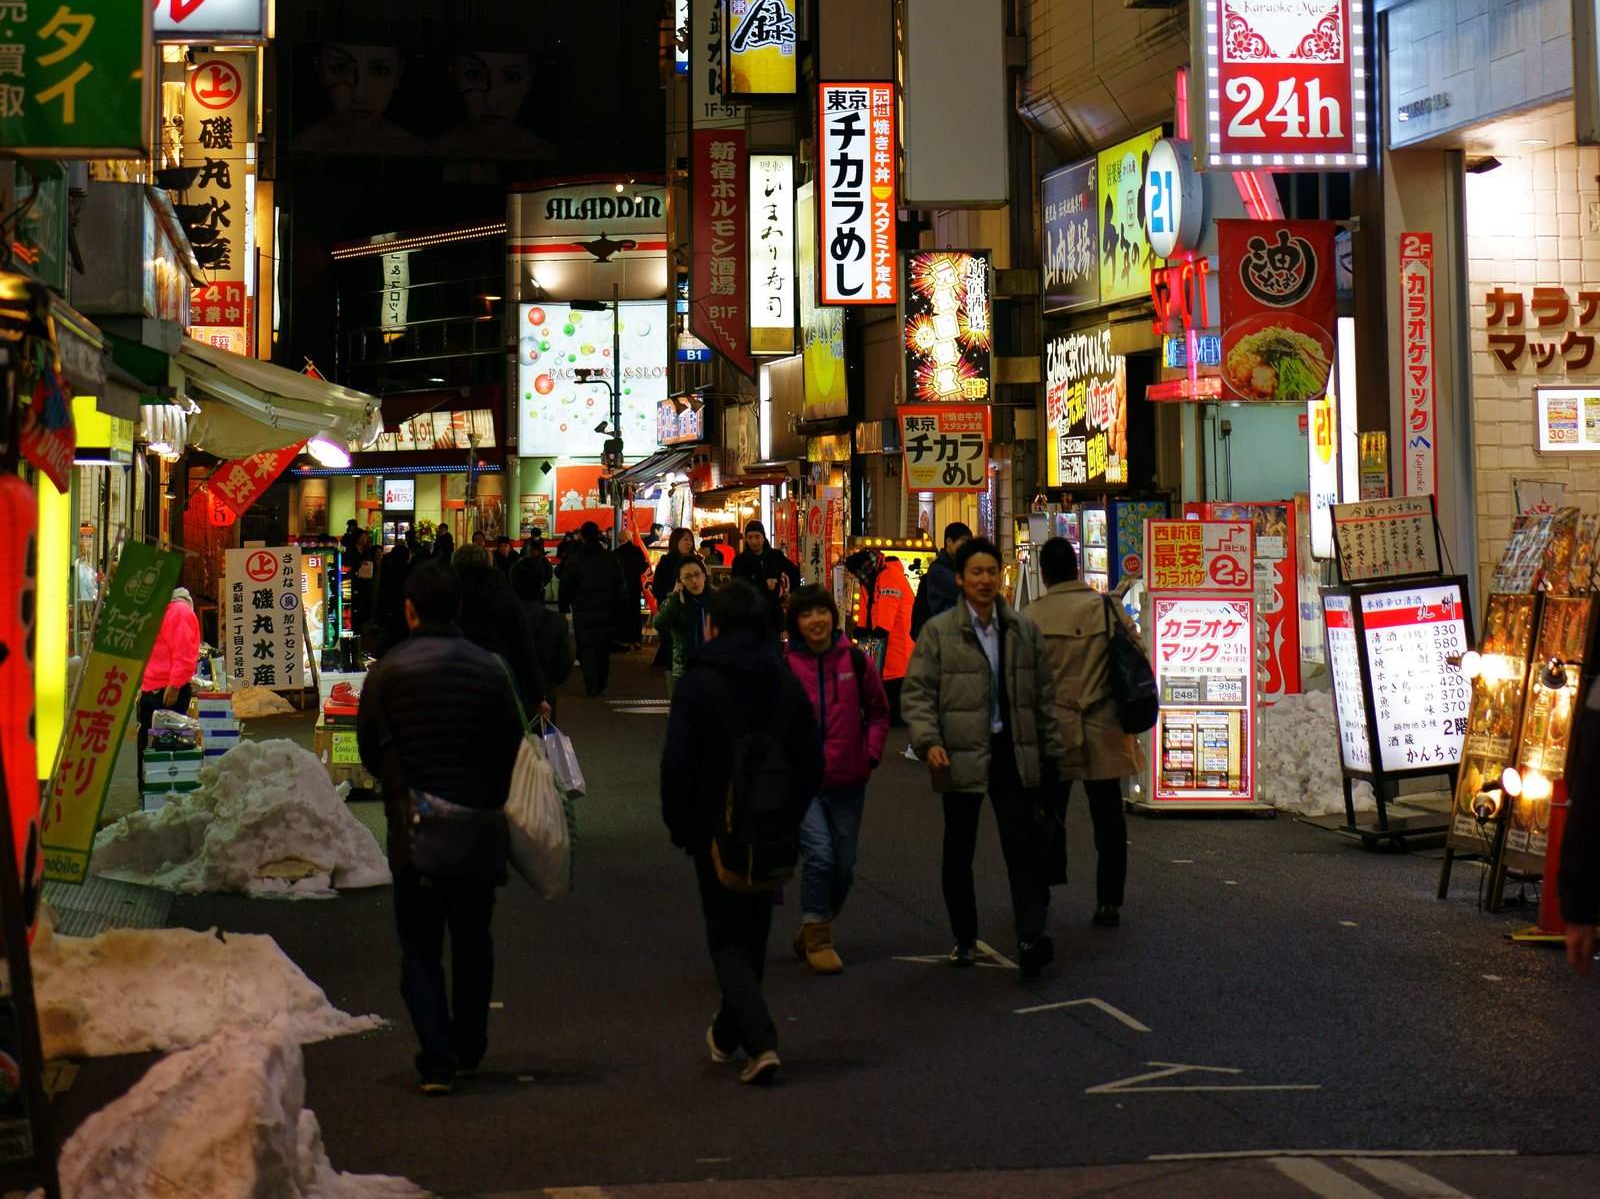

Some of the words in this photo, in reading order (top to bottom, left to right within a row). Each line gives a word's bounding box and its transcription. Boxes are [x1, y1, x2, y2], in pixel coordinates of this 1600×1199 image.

[1239, 0, 1293, 15] Karaoke
[1296, 0, 1325, 17] Mac
[827, 89, 868, 110] 東京
[875, 89, 888, 116] 元祖
[1225, 74, 1345, 140] 24h
[873, 119, 891, 184] 焼き牛丼
[545, 196, 662, 221] ALADDIN
[830, 112, 866, 297] チカラめし
[1150, 170, 1174, 233] 21
[709, 141, 736, 295] 新宿ホルモン酒場
[761, 178, 785, 318] ひまわり寿司
[875, 203, 892, 299] スタミナ定食
[1404, 235, 1431, 257] 2F
[190, 285, 241, 303] 24h
[709, 306, 738, 320] B1F
[686, 350, 702, 360] B1
[1408, 272, 1429, 433] カラオケマック
[1488, 331, 1595, 371] マック
[965, 388, 987, 398] B1F
[905, 417, 936, 432] 東京
[1316, 407, 1332, 446] 21
[906, 432, 984, 463] チカラ
[942, 462, 984, 486] めし
[1415, 451, 1424, 492] Karaoke
[1350, 503, 1423, 517] 今週のおすすめ
[1154, 525, 1203, 542] 西新宿
[1154, 543, 1204, 568] 最安
[1224, 544, 1248, 553] 当ビル
[282, 553, 294, 588] さかな
[1154, 570, 1206, 587] カラオケ
[1213, 557, 1248, 586] 2F
[108, 604, 152, 633] ケータイ
[232, 582, 245, 678] 西新宿一丁目2号店
[1161, 619, 1244, 639] カラオケ
[1433, 623, 1457, 636] 330
[102, 625, 138, 651] スマホ
[251, 587, 276, 686] 磯丸水産
[283, 613, 295, 685] 加工センター
[1434, 636, 1458, 649] 580
[1161, 642, 1219, 662] マック
[1440, 675, 1464, 686] 420
[1441, 688, 1465, 700] 370
[1442, 700, 1466, 713] 370
[73, 665, 129, 798] お売り
[1388, 733, 1415, 747] 酒蔵
